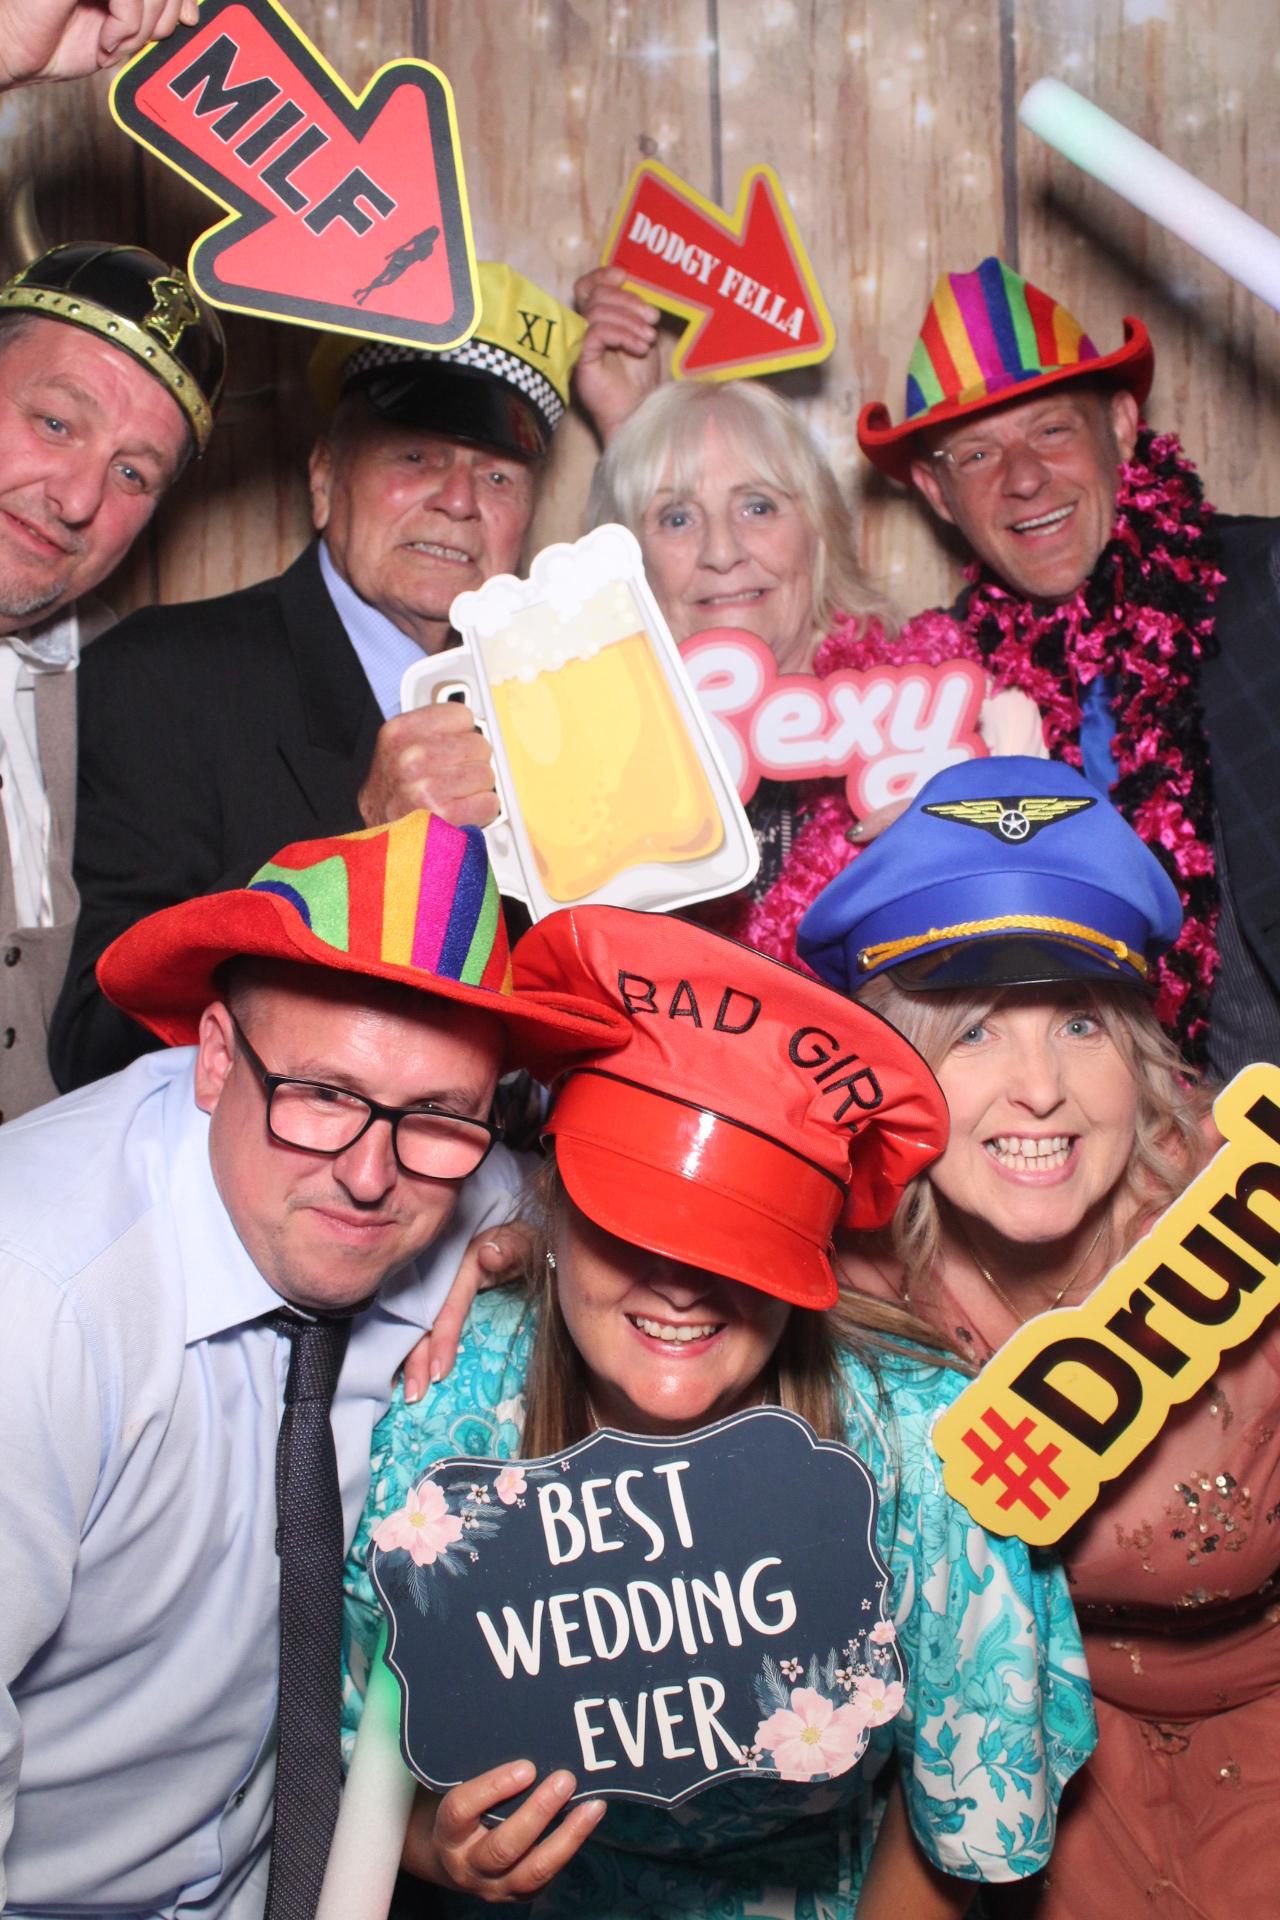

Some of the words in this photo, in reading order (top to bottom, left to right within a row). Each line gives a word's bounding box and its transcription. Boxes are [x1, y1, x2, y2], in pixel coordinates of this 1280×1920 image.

[167, 33, 397, 237] MILF
[628, 212, 721, 284] DODGY
[718, 266, 806, 341] FELLA
[618, 969, 761, 1034] BAD
[789, 1027, 884, 1133] GIR
[538, 1461, 693, 1565] BEST
[476, 1557, 798, 1679] WEDDING
[574, 1676, 743, 1771] EVER
